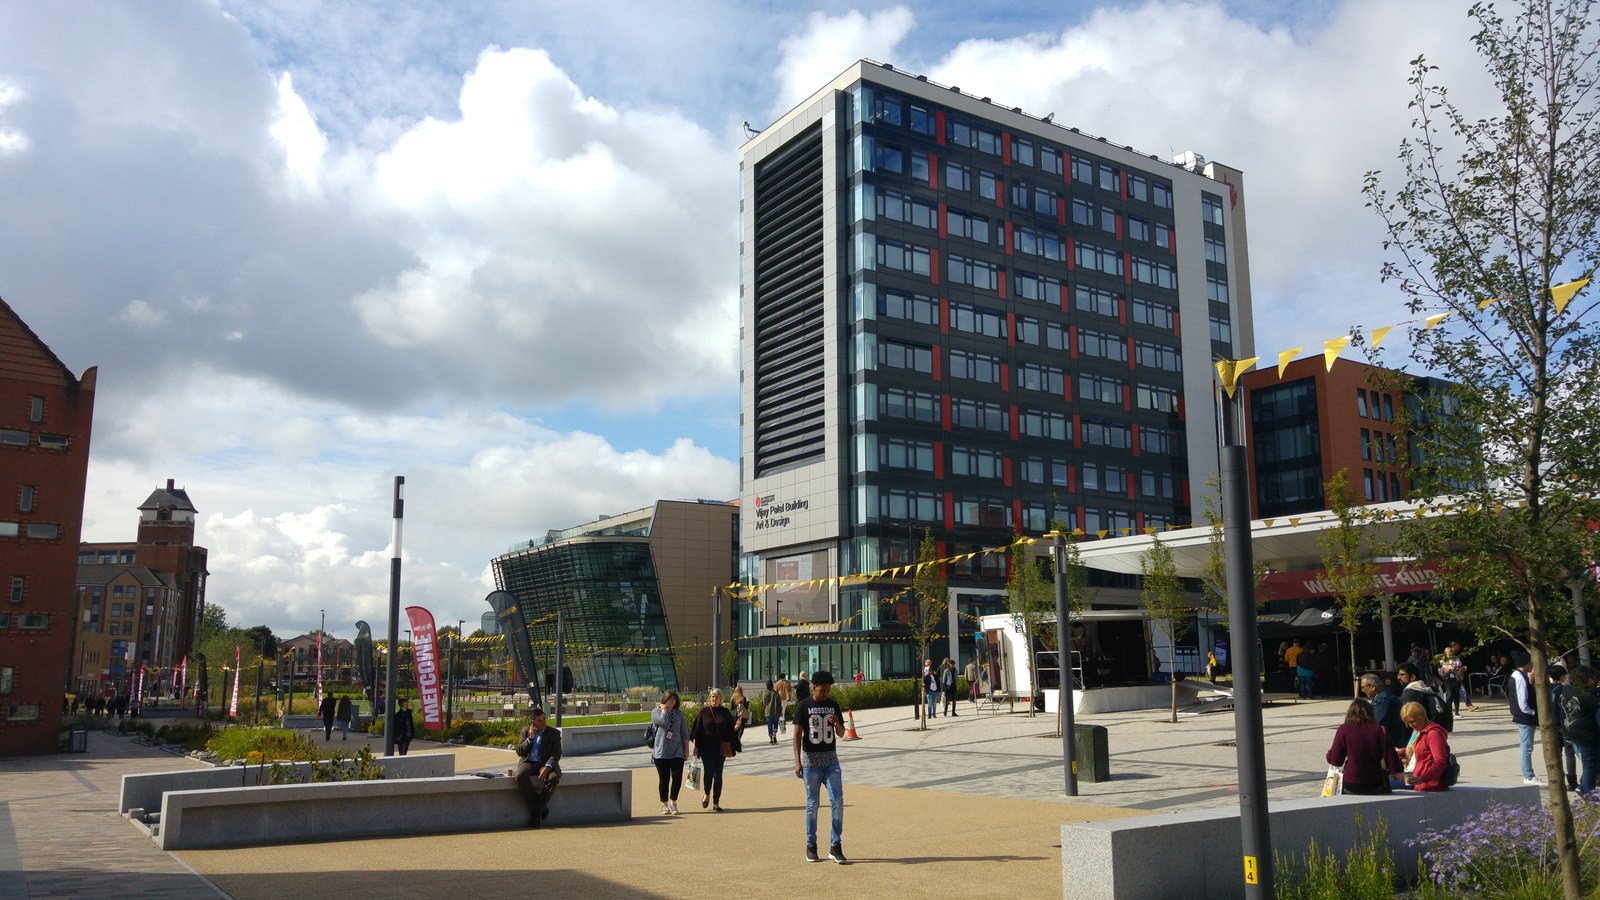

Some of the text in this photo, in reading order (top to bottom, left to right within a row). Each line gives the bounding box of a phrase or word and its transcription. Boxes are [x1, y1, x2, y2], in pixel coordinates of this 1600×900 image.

[755, 508, 769, 519] Vijay
[770, 503, 785, 515] Patel
[785, 499, 808, 512] Building
[755, 516, 790, 530] Art & Design
[808, 714, 834, 745] 86
